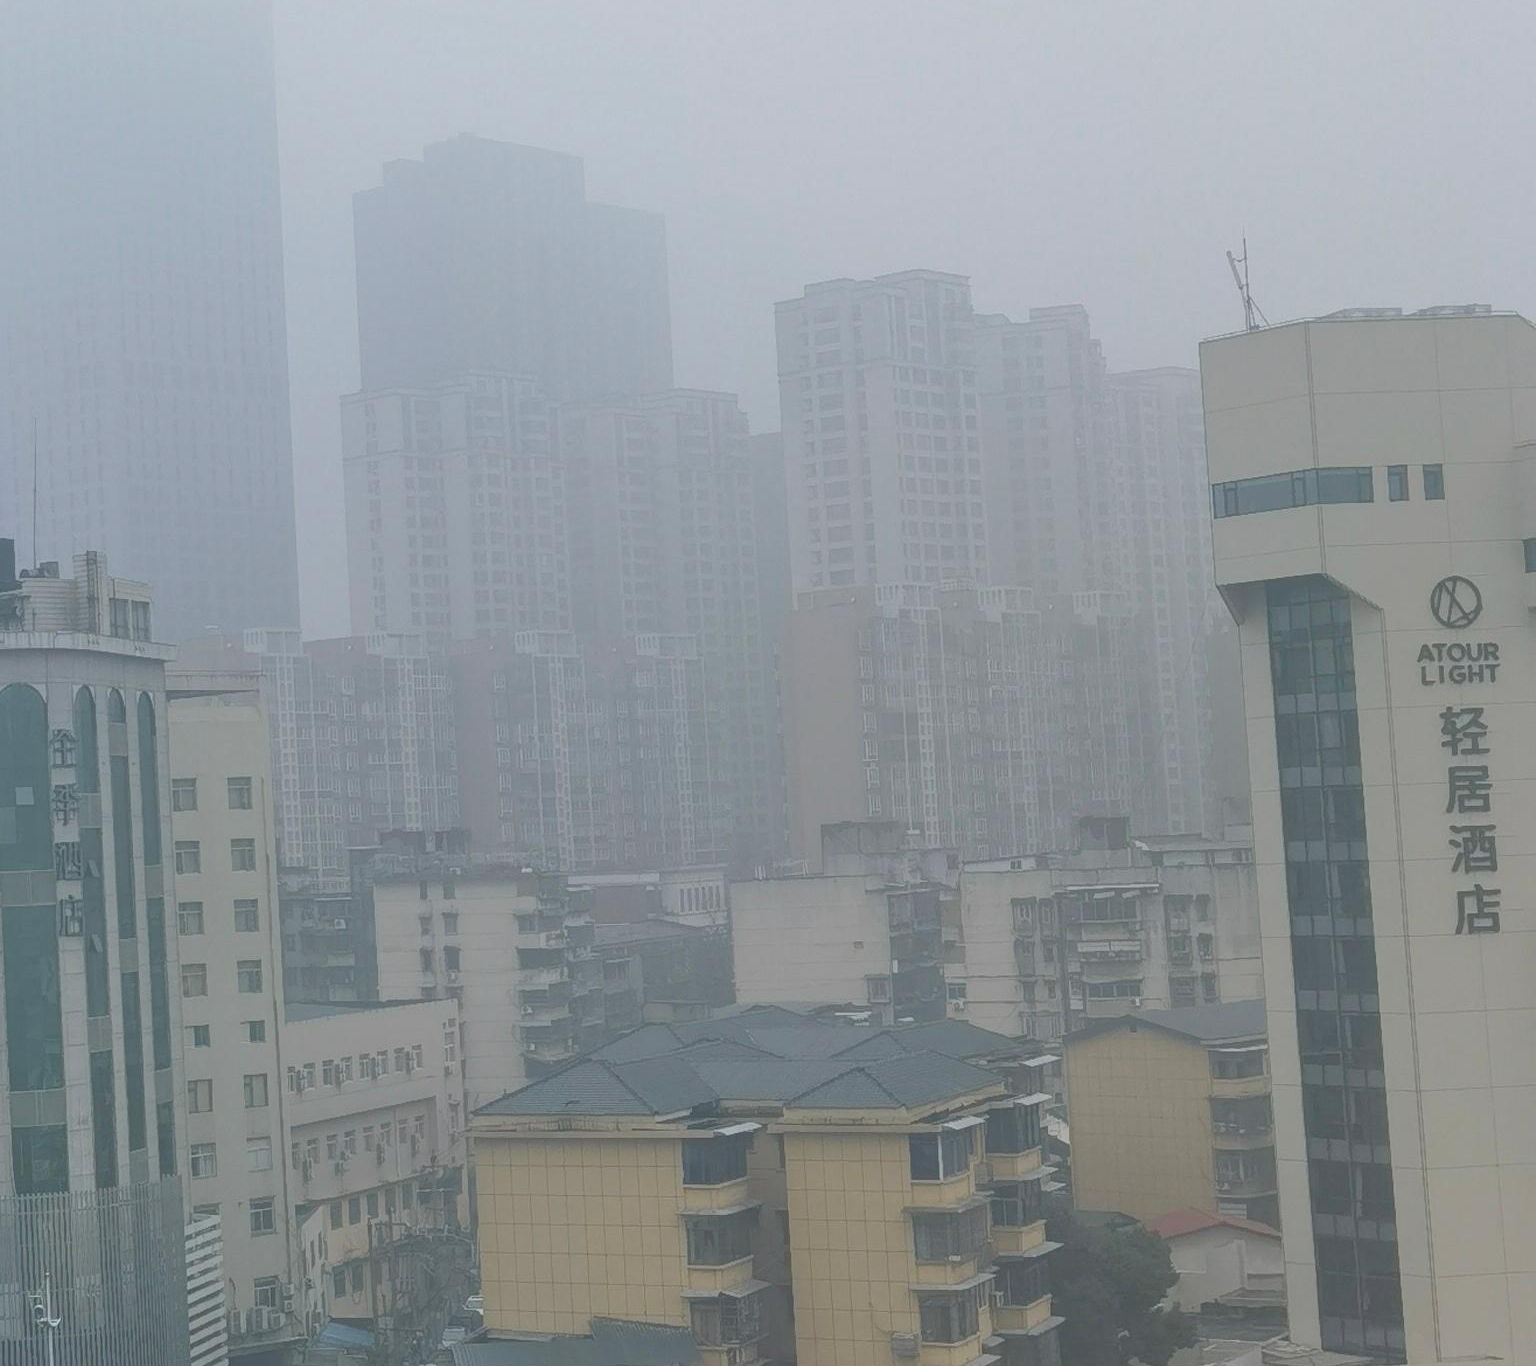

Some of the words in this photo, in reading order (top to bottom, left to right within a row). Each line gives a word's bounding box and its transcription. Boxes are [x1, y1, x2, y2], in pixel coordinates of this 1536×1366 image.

[1417, 641, 1501, 664] ATOUR
[1421, 664, 1501, 686] LIGHT
[1439, 705, 1502, 935] 轻居酒店
